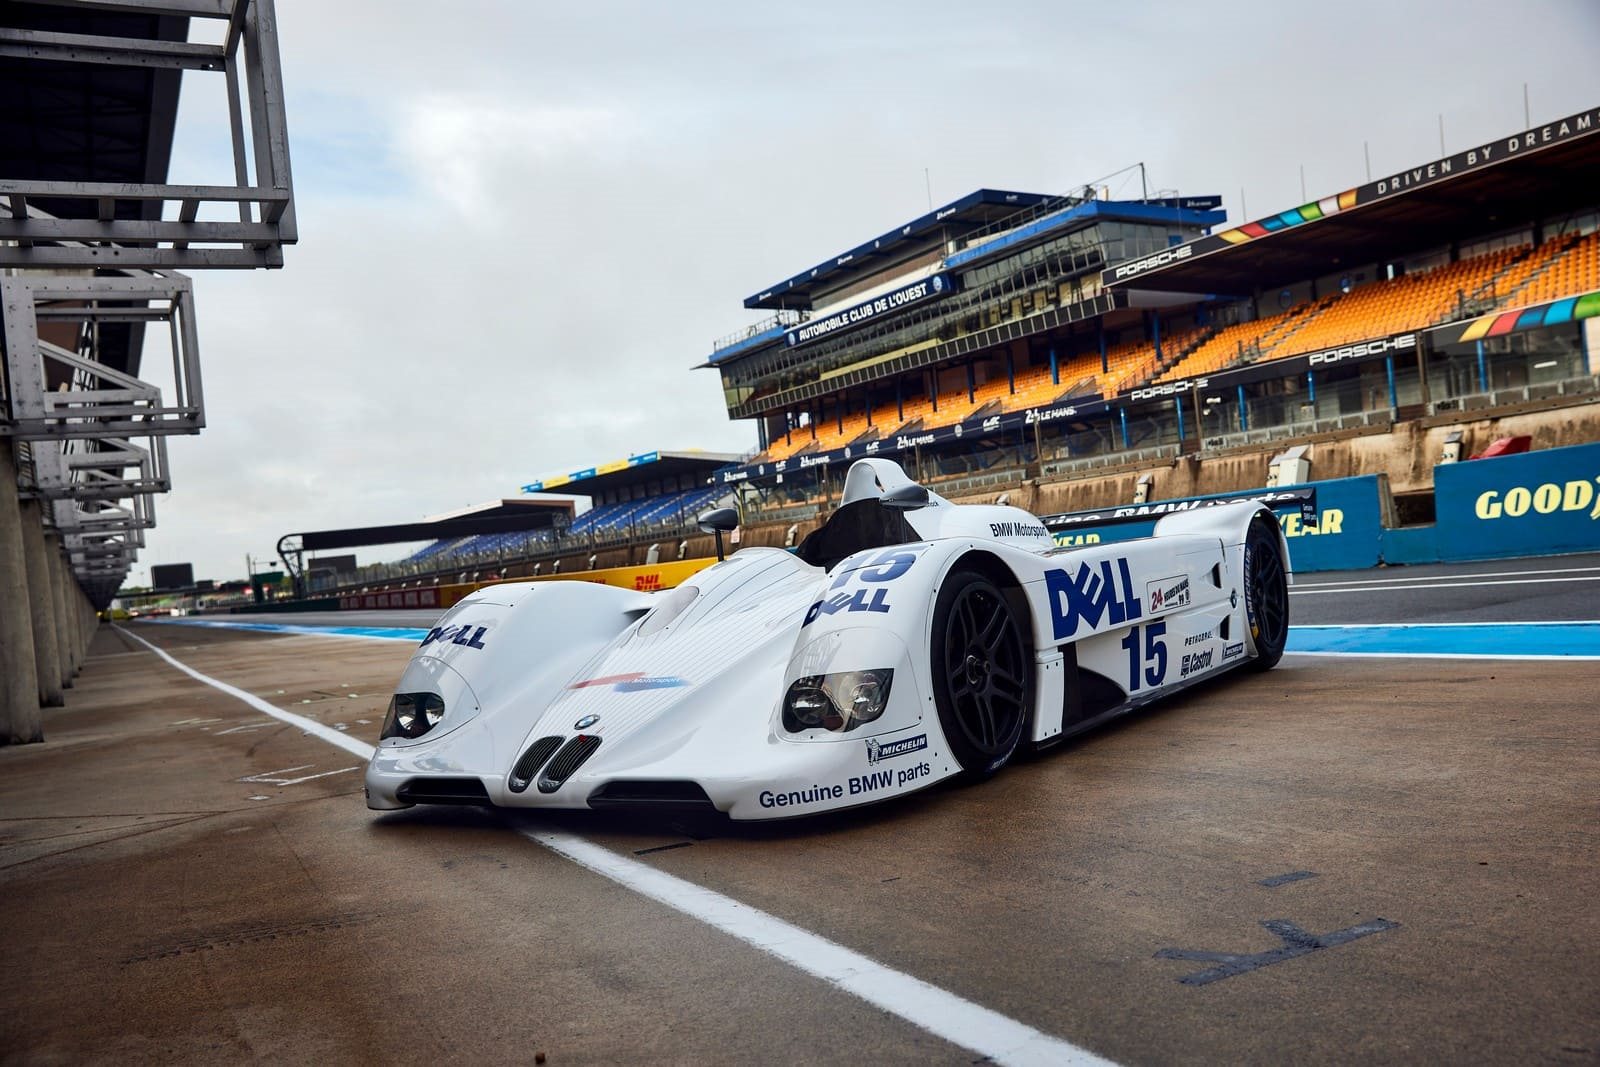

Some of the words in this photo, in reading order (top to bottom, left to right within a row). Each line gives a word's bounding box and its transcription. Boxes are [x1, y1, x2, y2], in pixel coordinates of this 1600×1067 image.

[1377, 159, 1452, 195] DRIVEN
[1467, 146, 1492, 166] BY
[1508, 110, 1600, 153] DREAM
[1115, 244, 1193, 279] PORSCHE
[799, 313, 850, 342] AUTOMOBILE
[849, 303, 874, 323] CLUB
[875, 299, 888, 314] DE
[889, 282, 928, 307] L'OUEST
[1310, 333, 1417, 367] PORSCHE
[1131, 378, 1209, 402] PORSCHE
[1040, 409, 1052, 421] LE
[1051, 406, 1076, 419] MANS
[990, 522, 1013, 538] BMW
[1014, 521, 1048, 539] Motorsport
[829, 545, 930, 591] 15
[801, 588, 891, 630] DELL
[1044, 557, 1142, 641] DELL
[1151, 587, 1164, 611] 24
[419, 623, 488, 650] DELL
[1121, 620, 1168, 692] 15
[1190, 648, 1214, 674] Castrol
[881, 736, 926, 756] MICHELIN
[759, 784, 843, 808] Genuine
[849, 769, 894, 796] BMW
[897, 761, 931, 787] parts
